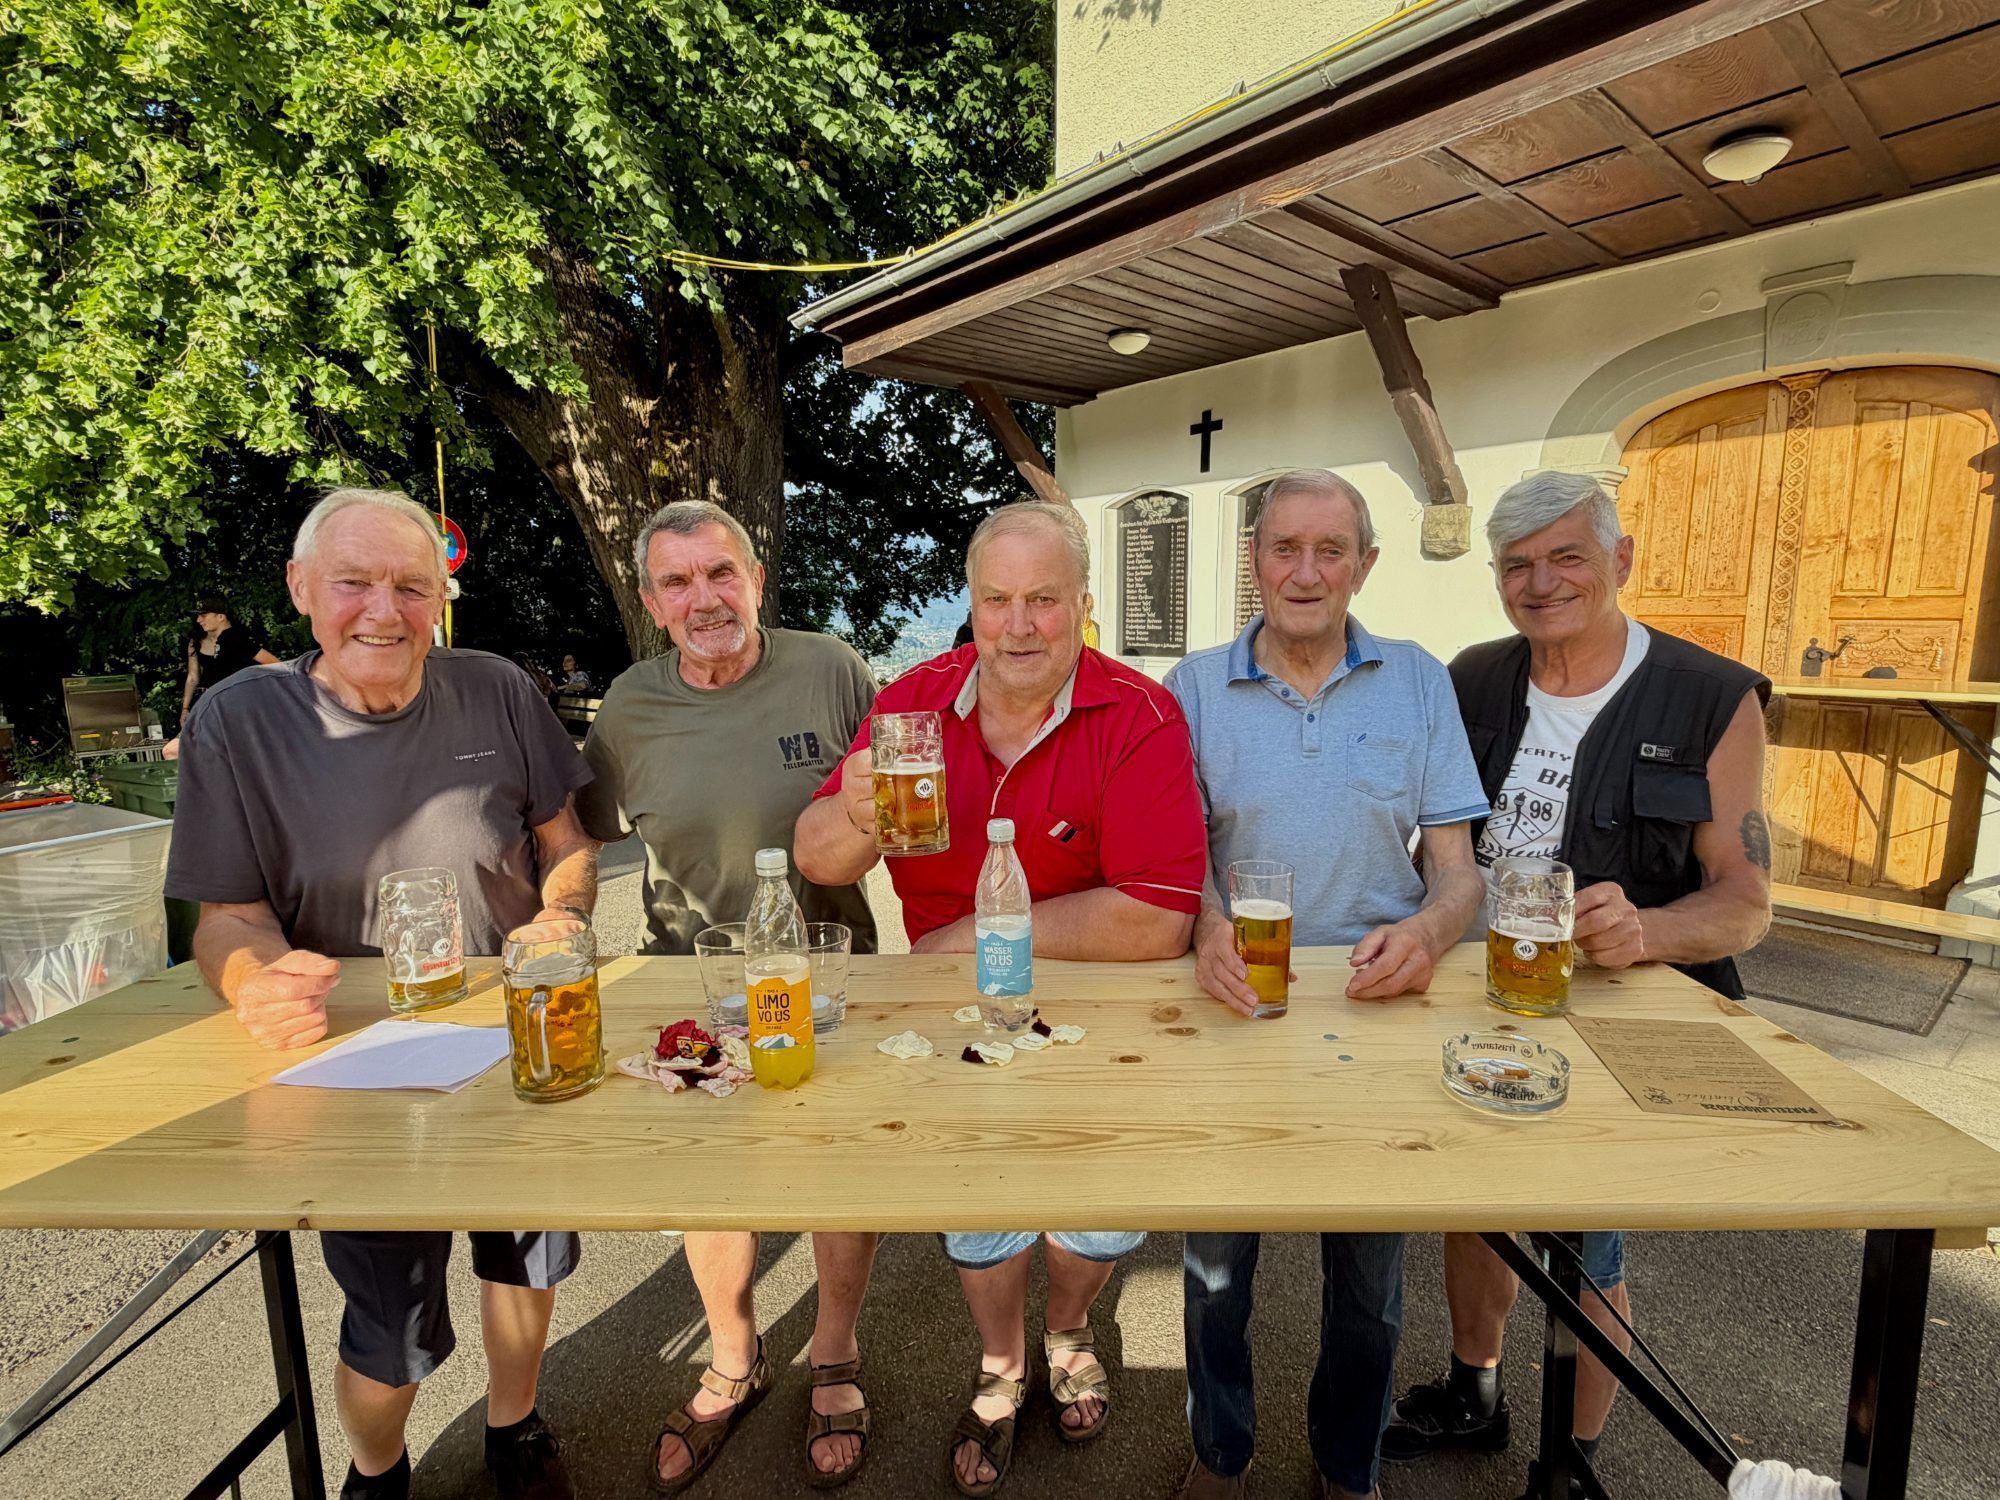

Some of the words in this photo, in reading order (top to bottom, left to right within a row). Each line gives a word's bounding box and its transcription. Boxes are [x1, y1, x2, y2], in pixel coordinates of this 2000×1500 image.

[454, 753, 476, 762] TOMMY
[477, 750, 496, 759] JEANS
[1529, 800, 1553, 821] 98
[984, 945, 1012, 954] WASSER
[984, 954, 997, 965] VO
[756, 993, 789, 1009] LIMO
[757, 1010, 772, 1023] VO
